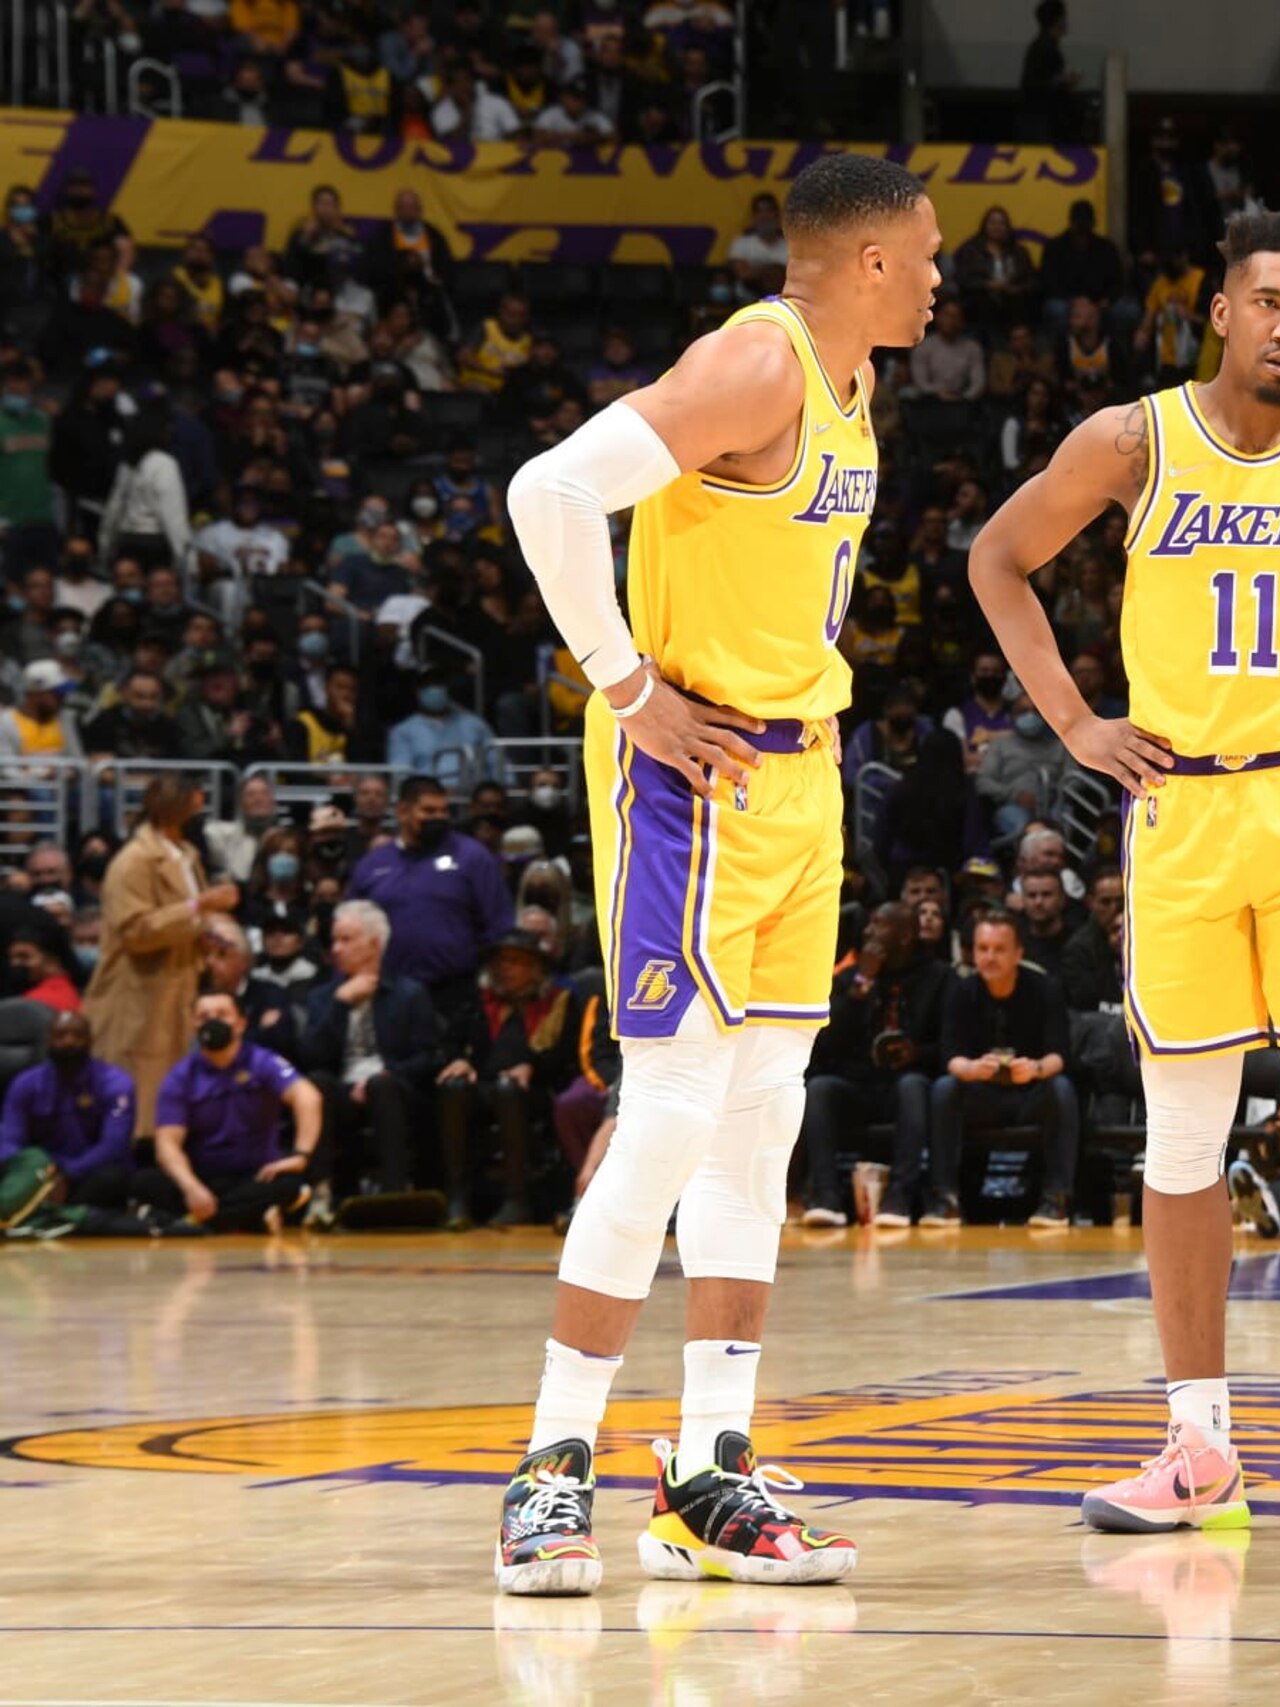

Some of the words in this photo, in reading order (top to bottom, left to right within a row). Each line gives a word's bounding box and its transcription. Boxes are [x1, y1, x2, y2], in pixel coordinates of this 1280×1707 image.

[792, 453, 878, 525] LAKER
[824, 539, 851, 642] 0
[1209, 571, 1279, 669] 11
